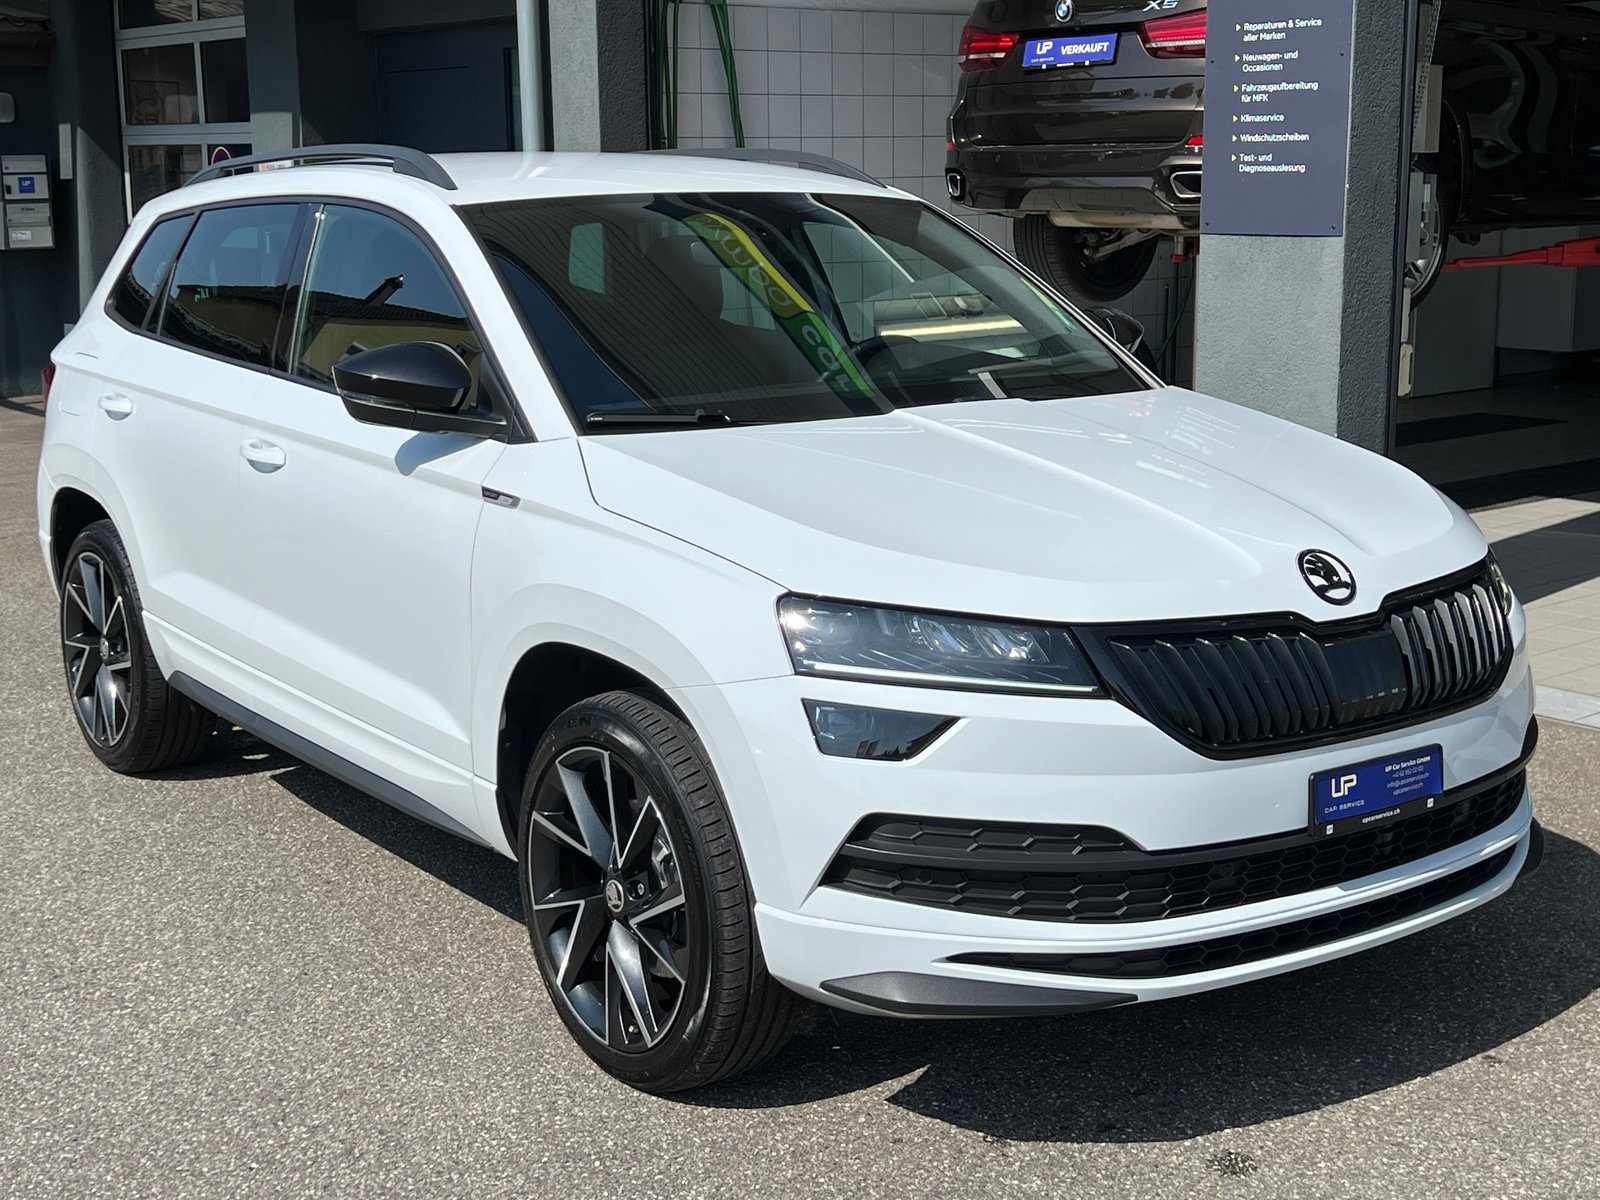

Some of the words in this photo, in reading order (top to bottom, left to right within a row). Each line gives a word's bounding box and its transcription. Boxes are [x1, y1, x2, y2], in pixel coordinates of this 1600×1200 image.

[1142, 0, 1180, 12] X5
[1243, 20, 1287, 32] Reparaturen
[1288, 19, 1294, 28] &
[1295, 18, 1322, 28] Service
[1243, 33, 1259, 42] aller
[1259, 32, 1286, 41] Marken
[1061, 42, 1110, 55] VERKAUFT
[1242, 53, 1282, 62] Neuwagen-
[1283, 50, 1298, 60] und
[1242, 63, 1283, 73] Occasionen
[1241, 81, 1319, 92] Fahrzeugaufbereitung
[1241, 94, 1251, 103] für
[1252, 93, 1269, 102] MFK
[1240, 113, 1285, 123] Klimaservice
[1240, 133, 1310, 143] Windschutzscheiben
[1239, 154, 1257, 162] Test-
[1258, 153, 1273, 162] und
[1238, 163, 1306, 174] Diagnoseauslesung
[1331, 774, 1357, 798] UP
[1324, 805, 1338, 814] CAR
[1339, 799, 1365, 811] SERVICE
